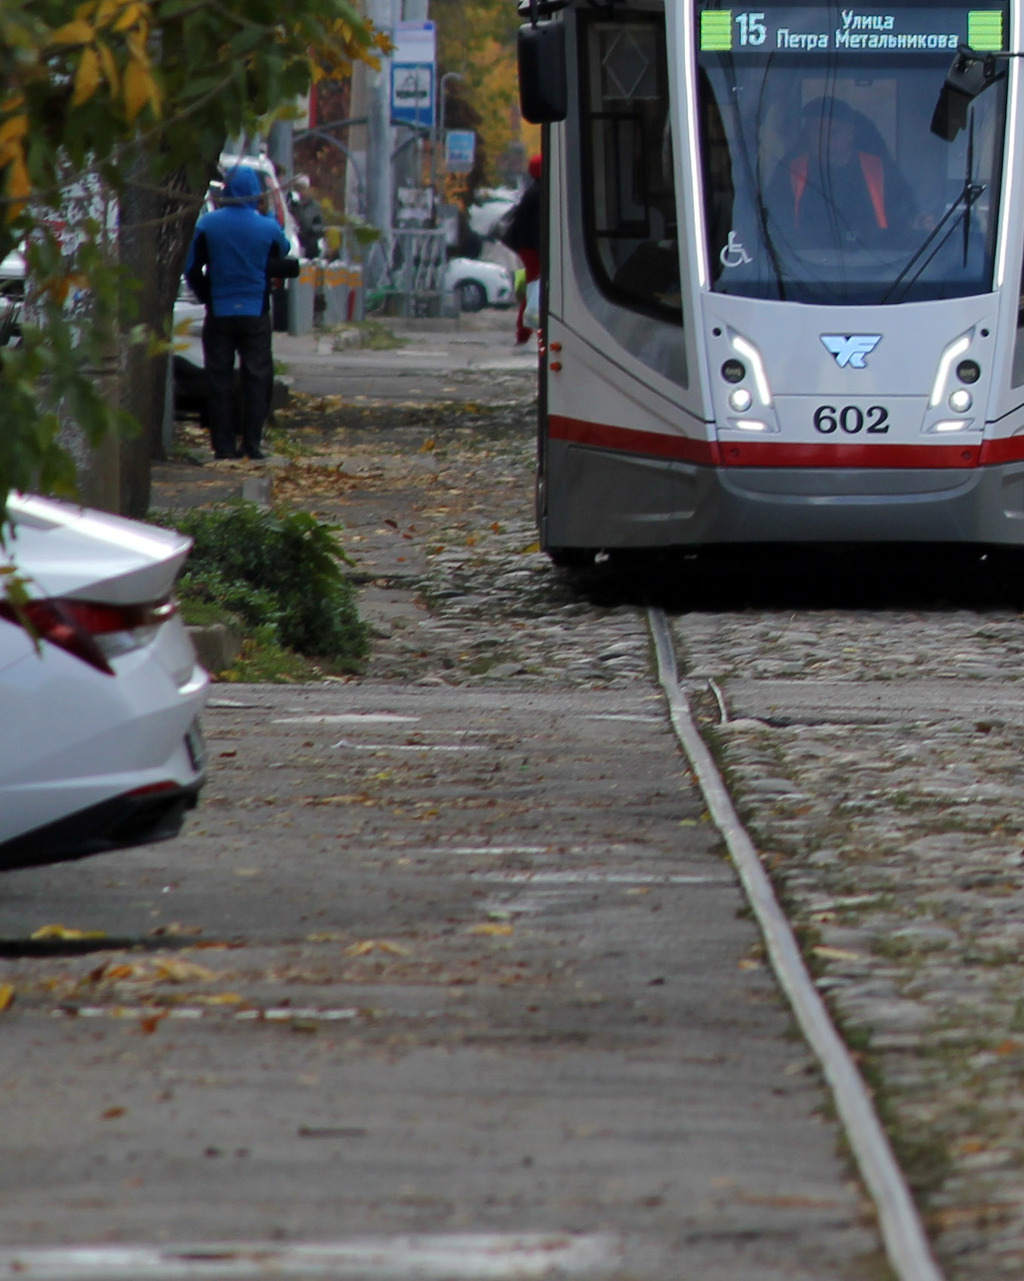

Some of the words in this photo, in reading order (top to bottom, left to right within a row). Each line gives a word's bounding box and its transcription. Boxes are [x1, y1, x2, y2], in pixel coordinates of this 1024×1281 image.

[735, 12, 767, 46] 15
[841, 10, 895, 30] Улица
[777, 28, 828, 51] Петра
[835, 29, 959, 49] Метальникова
[813, 405, 890, 434] 602
